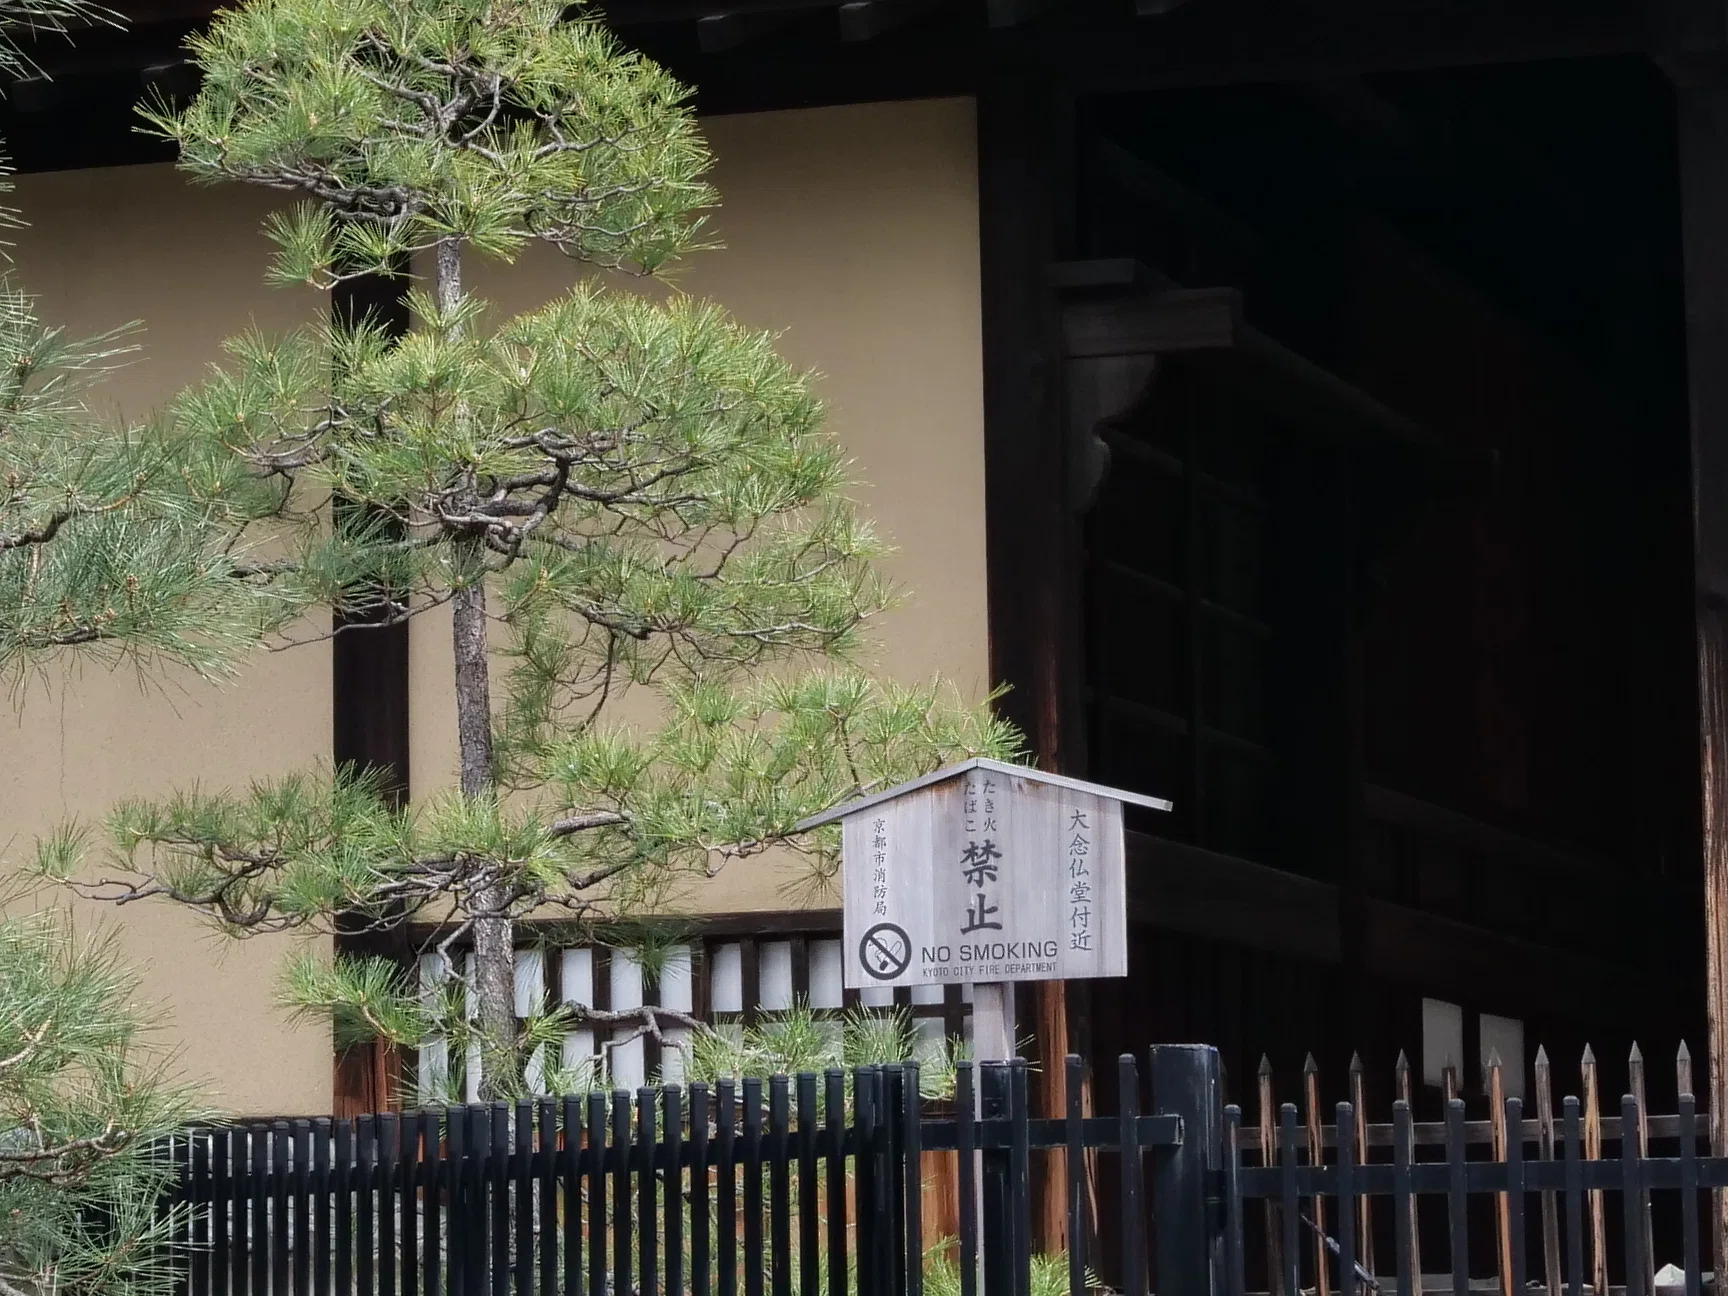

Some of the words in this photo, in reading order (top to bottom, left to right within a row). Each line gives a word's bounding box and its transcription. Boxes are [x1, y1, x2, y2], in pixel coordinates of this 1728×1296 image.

[963, 781, 977, 832] たばこ
[983, 779, 997, 832] たき火
[873, 818, 888, 916] 京都市消防局
[960, 839, 1003, 935] 禁止
[1068, 809, 1092, 952] 大念仏堂付近
[922, 946, 951, 963] NO
[959, 940, 1058, 962] SMOKING
[923, 966, 949, 978] KYOTO
[953, 965, 974, 977] CITY
[979, 964, 1000, 976] FIRE
[1004, 961, 1057, 975] DEPARTMENT
